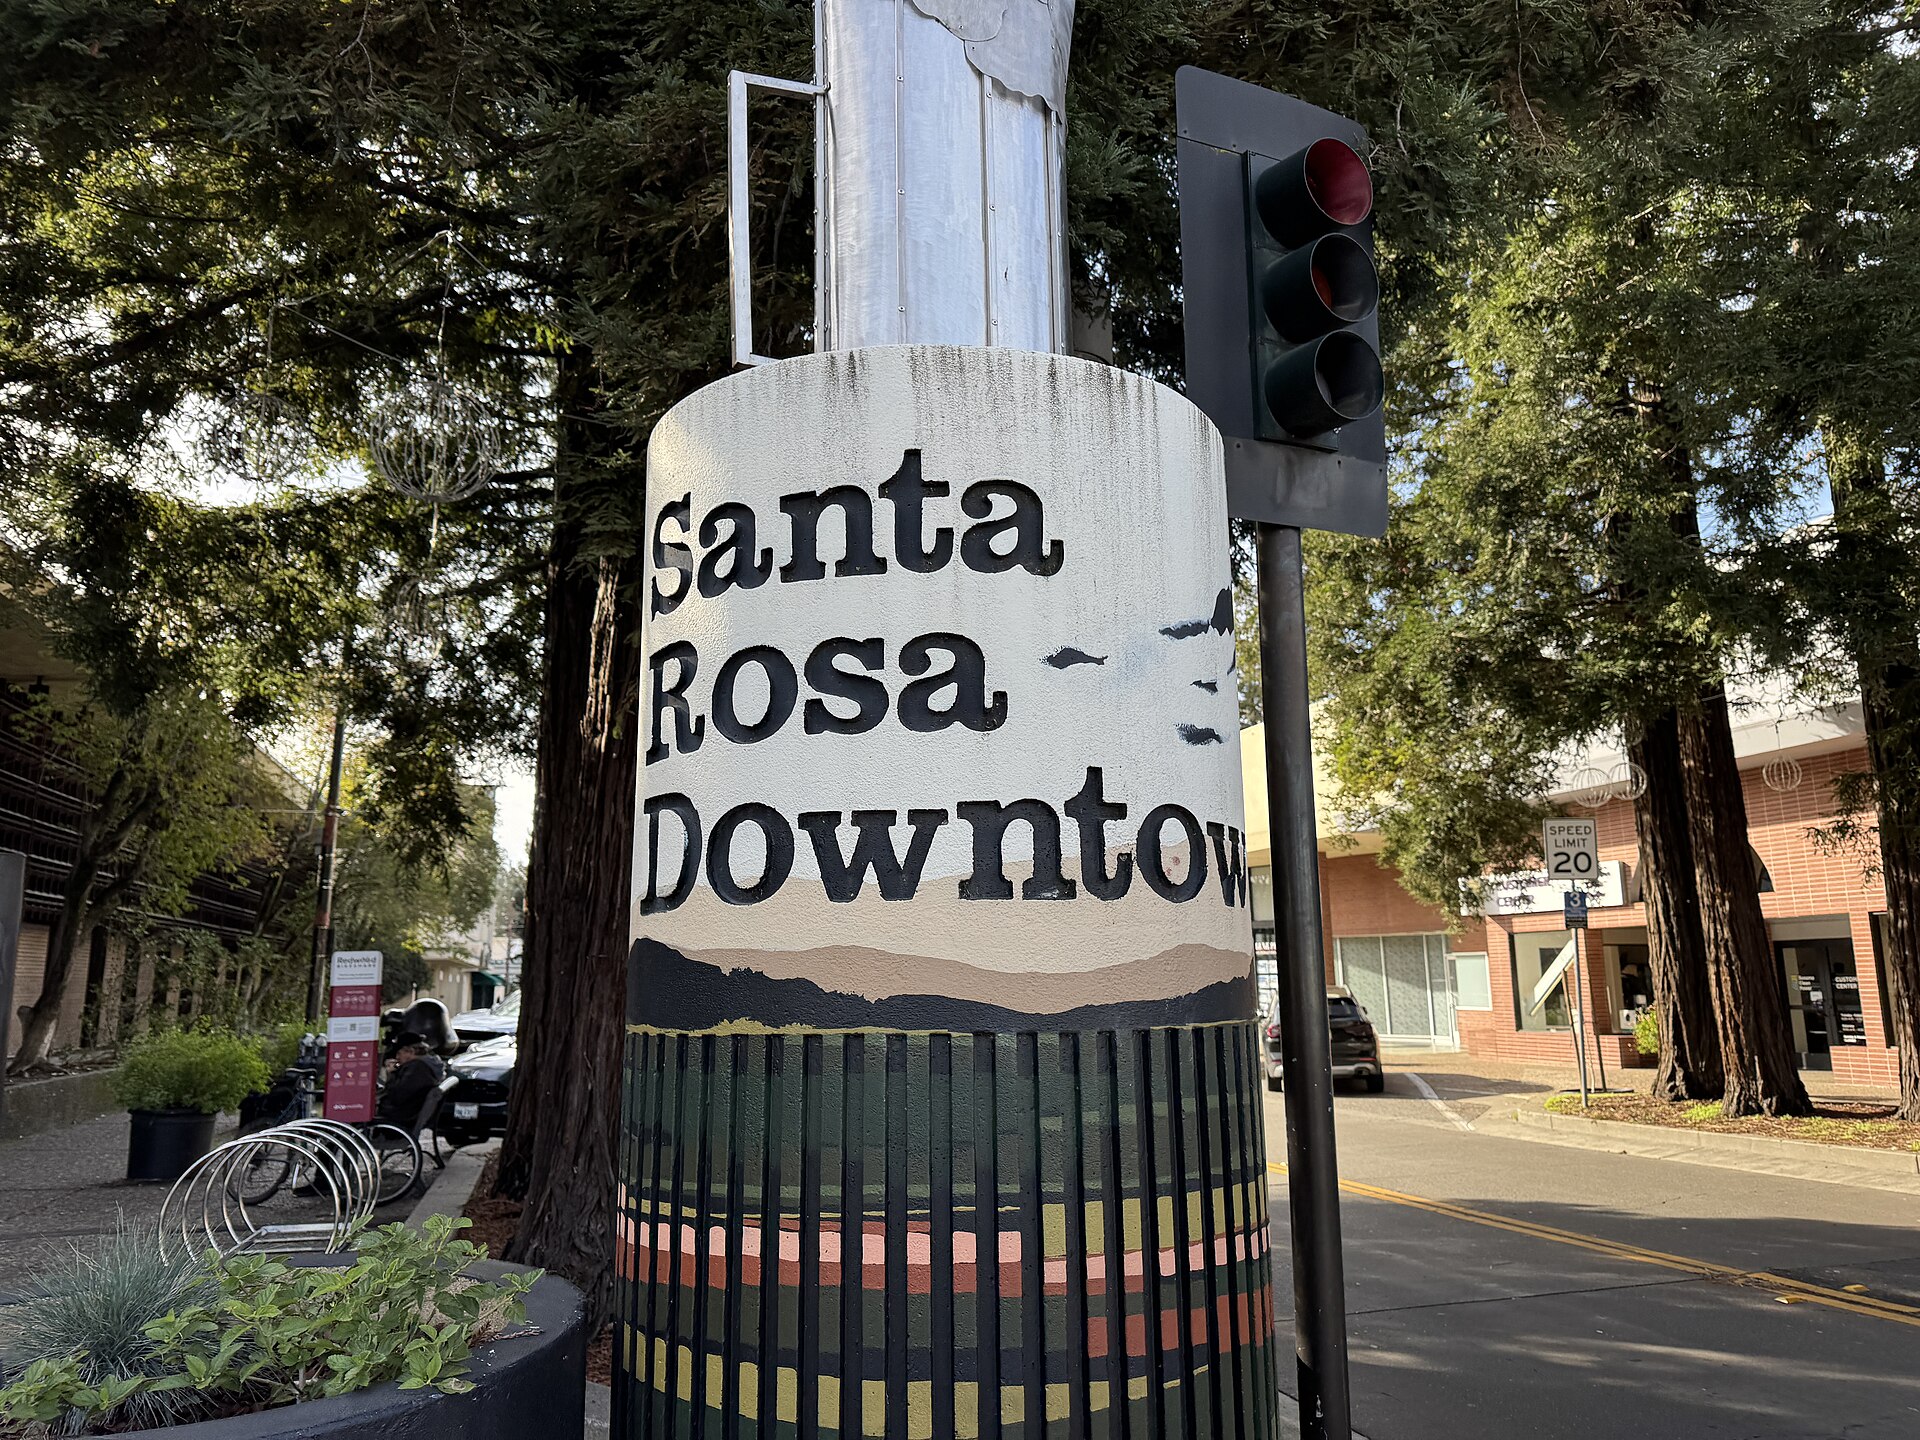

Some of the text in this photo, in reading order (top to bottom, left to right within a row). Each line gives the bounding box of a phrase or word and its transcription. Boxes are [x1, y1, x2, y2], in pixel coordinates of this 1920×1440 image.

[651, 448, 1064, 622] Santa
[646, 631, 1008, 766] Rosa
[1549, 825, 1592, 836] SPEED
[1554, 838, 1588, 848] LIMIT
[1553, 851, 1592, 873] 20
[1569, 892, 1581, 907] 3
